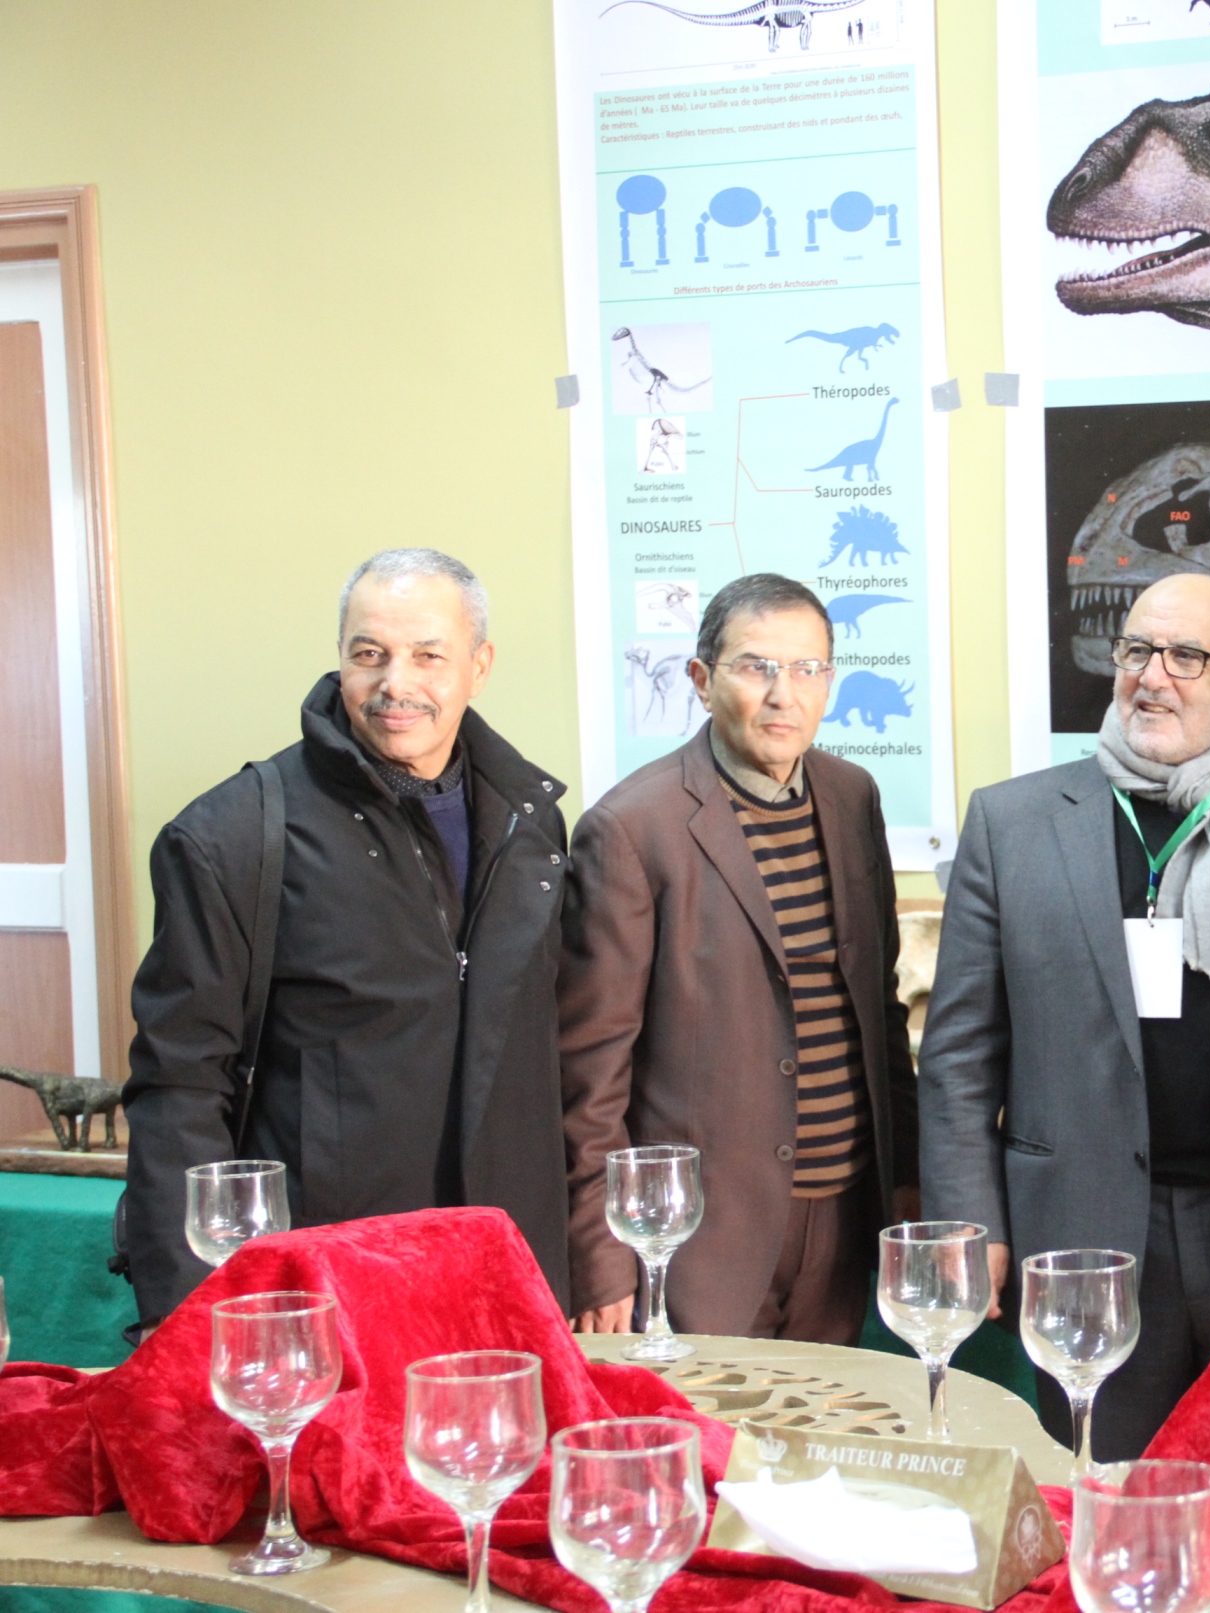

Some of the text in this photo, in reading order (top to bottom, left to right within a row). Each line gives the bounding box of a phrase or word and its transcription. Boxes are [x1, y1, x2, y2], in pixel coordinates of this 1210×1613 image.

[600, 97, 611, 105] Les
[614, 94, 655, 104] Dinosaures
[657, 92, 670, 100] ont
[673, 90, 690, 99] vécu
[693, 89, 697, 97] à
[700, 88, 707, 96] la
[710, 87, 737, 96] surface
[740, 85, 749, 93] de
[753, 84, 759, 92] la
[762, 83, 781, 91] Terre
[784, 81, 802, 90] pour
[823, 77, 845, 86] durée
[848, 75, 857, 83] de
[878, 71, 909, 80] millions
[641, 106, 654, 115] Ma
[691, 101, 707, 110] Leur
[710, 100, 728, 109] taille
[741, 98, 750, 106] de
[753, 96, 787, 106] quelques
[789, 92, 831, 102] décimètres
[833, 89, 838, 98] à
[840, 87, 875, 98] plusieurs
[877, 84, 909, 94] dizaines
[601, 123, 609, 131] de
[601, 132, 660, 144] Caractéristiques
[666, 128, 695, 139] Reptiles
[698, 126, 736, 136] terrestres,
[739, 122, 785, 133] construisant
[787, 120, 800, 128] des
[802, 118, 818, 127] nids
[830, 115, 863, 126] pondant
[865, 113, 879, 122] des
[674, 278, 838, 295] Différents types de ports des Archosauriens
[812, 383, 890, 400] Théropodes
[634, 482, 685, 492] Saurischiens
[815, 483, 892, 500] Sauropodes
[627, 494, 693, 504] Bassin dit de reptile
[1170, 511, 1191, 521] FAO
[621, 520, 702, 534] DINOSAURES
[635, 552, 694, 562] Ornithischiens
[817, 575, 908, 591] Thyréophores
[832, 653, 911, 668] nithopodes
[805, 1443, 967, 1477] TRAITEUR PRINCE
